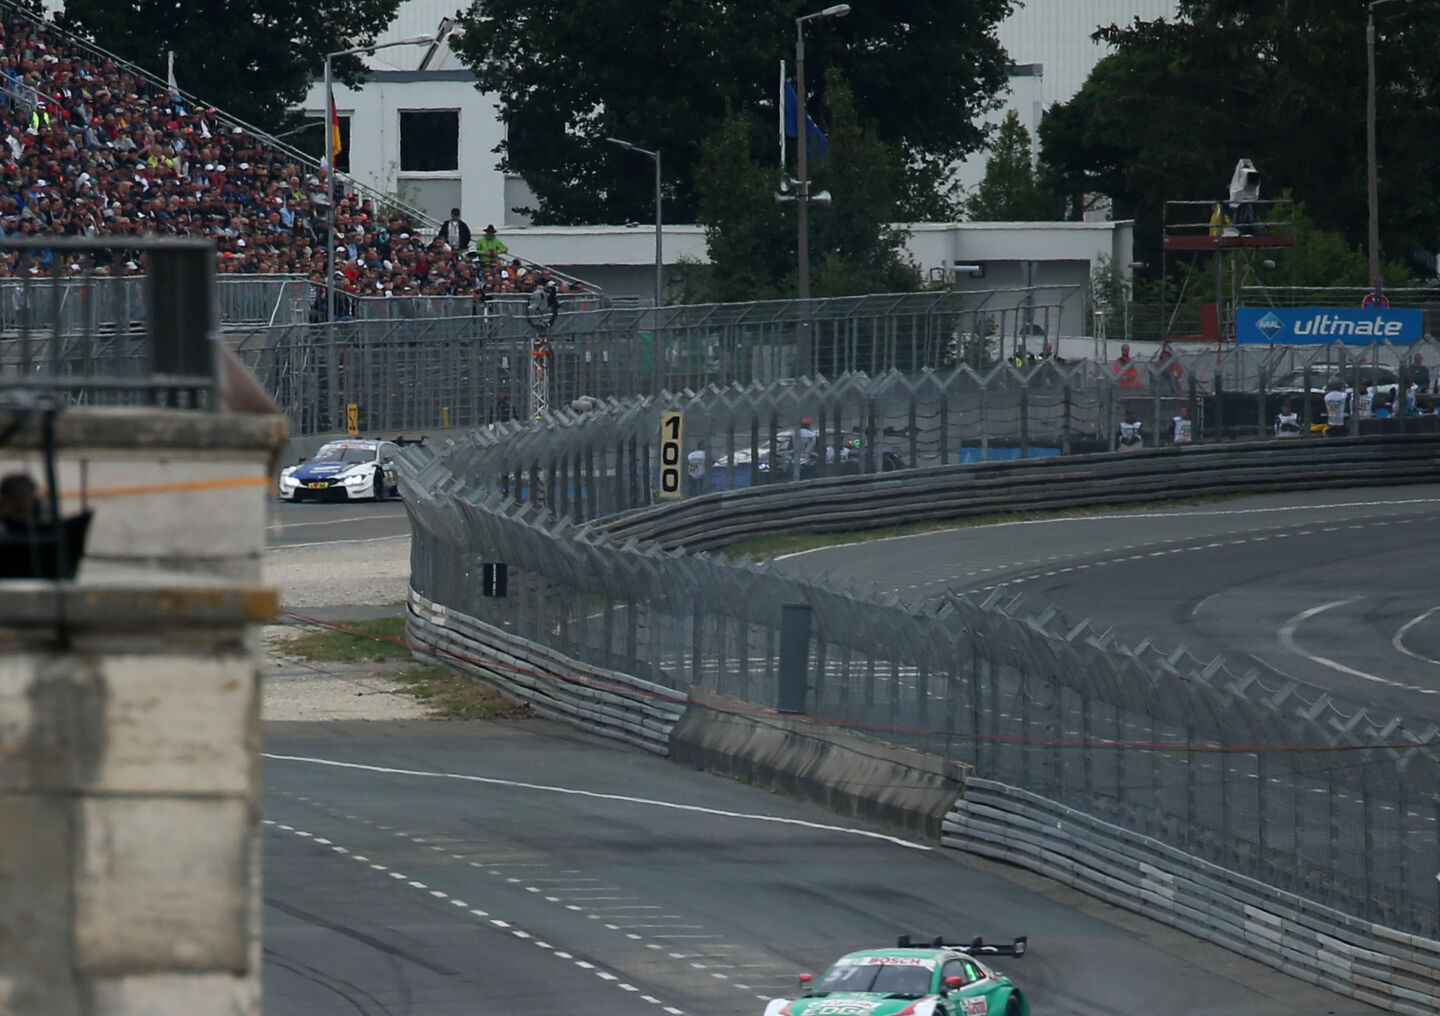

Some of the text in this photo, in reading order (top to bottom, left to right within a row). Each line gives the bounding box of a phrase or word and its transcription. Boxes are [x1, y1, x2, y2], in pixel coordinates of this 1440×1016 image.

[1294, 315, 1403, 336] ultimate
[662, 416, 680, 492] 100
[868, 957, 921, 965] BOSCH
[800, 1007, 875, 1016] EDGE
